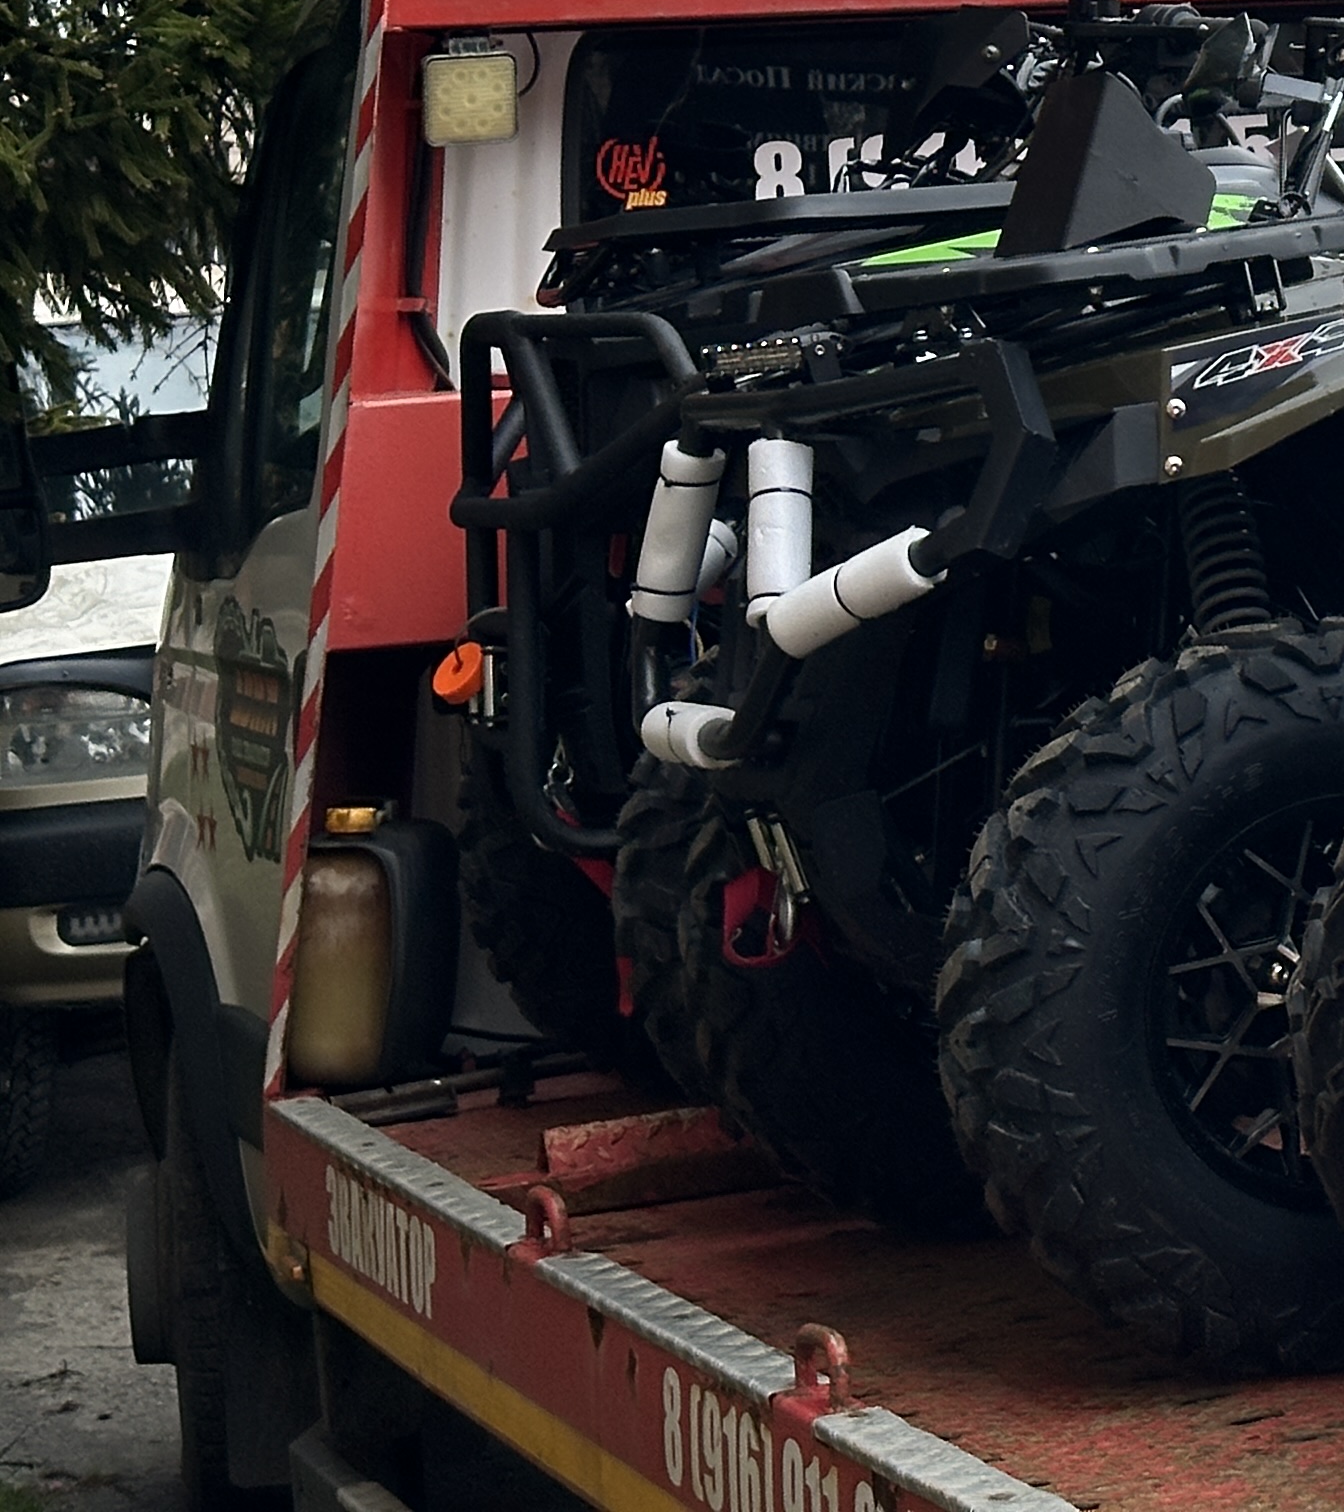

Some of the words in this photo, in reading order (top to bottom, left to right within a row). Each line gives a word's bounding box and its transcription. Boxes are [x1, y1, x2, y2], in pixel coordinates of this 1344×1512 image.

[625, 188, 667, 211] plus
[325, 1164, 436, 1320] ЭВАКУАТОР
[662, 1366, 683, 1487] 8
[690, 1383, 774, 1512] (916)
